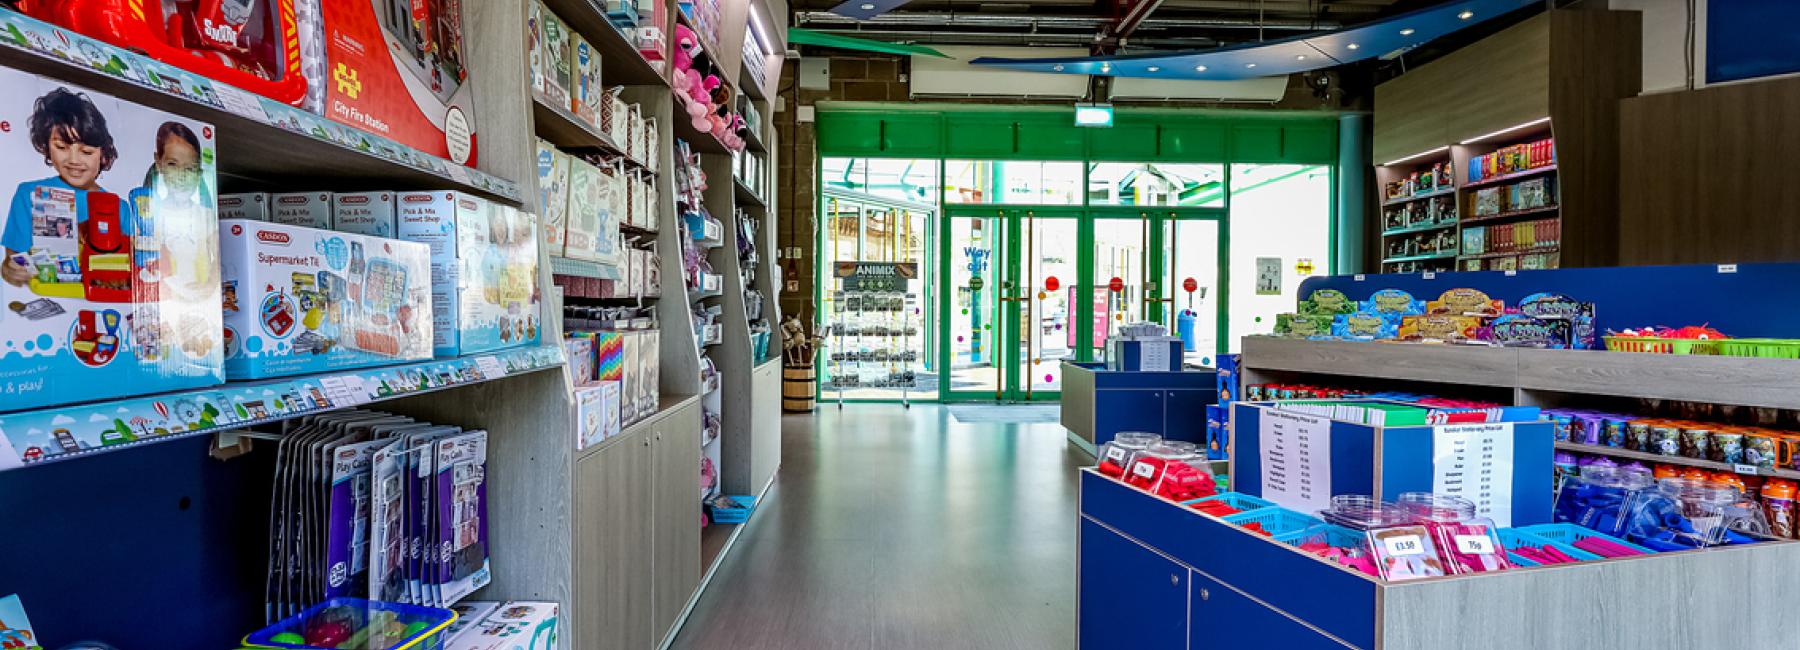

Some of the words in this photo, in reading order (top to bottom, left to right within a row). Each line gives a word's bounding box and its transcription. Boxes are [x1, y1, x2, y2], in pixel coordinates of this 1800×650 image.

[334, 101, 350, 118] City
[350, 107, 364, 122] Fire
[364, 113, 390, 133] Station
[424, 216, 440, 224] Shop
[964, 247, 991, 258] Way
[258, 252, 309, 267] Supermarket
[856, 265, 896, 276] ANIMIX
[967, 261, 988, 271] out
[336, 461, 350, 473] Play
